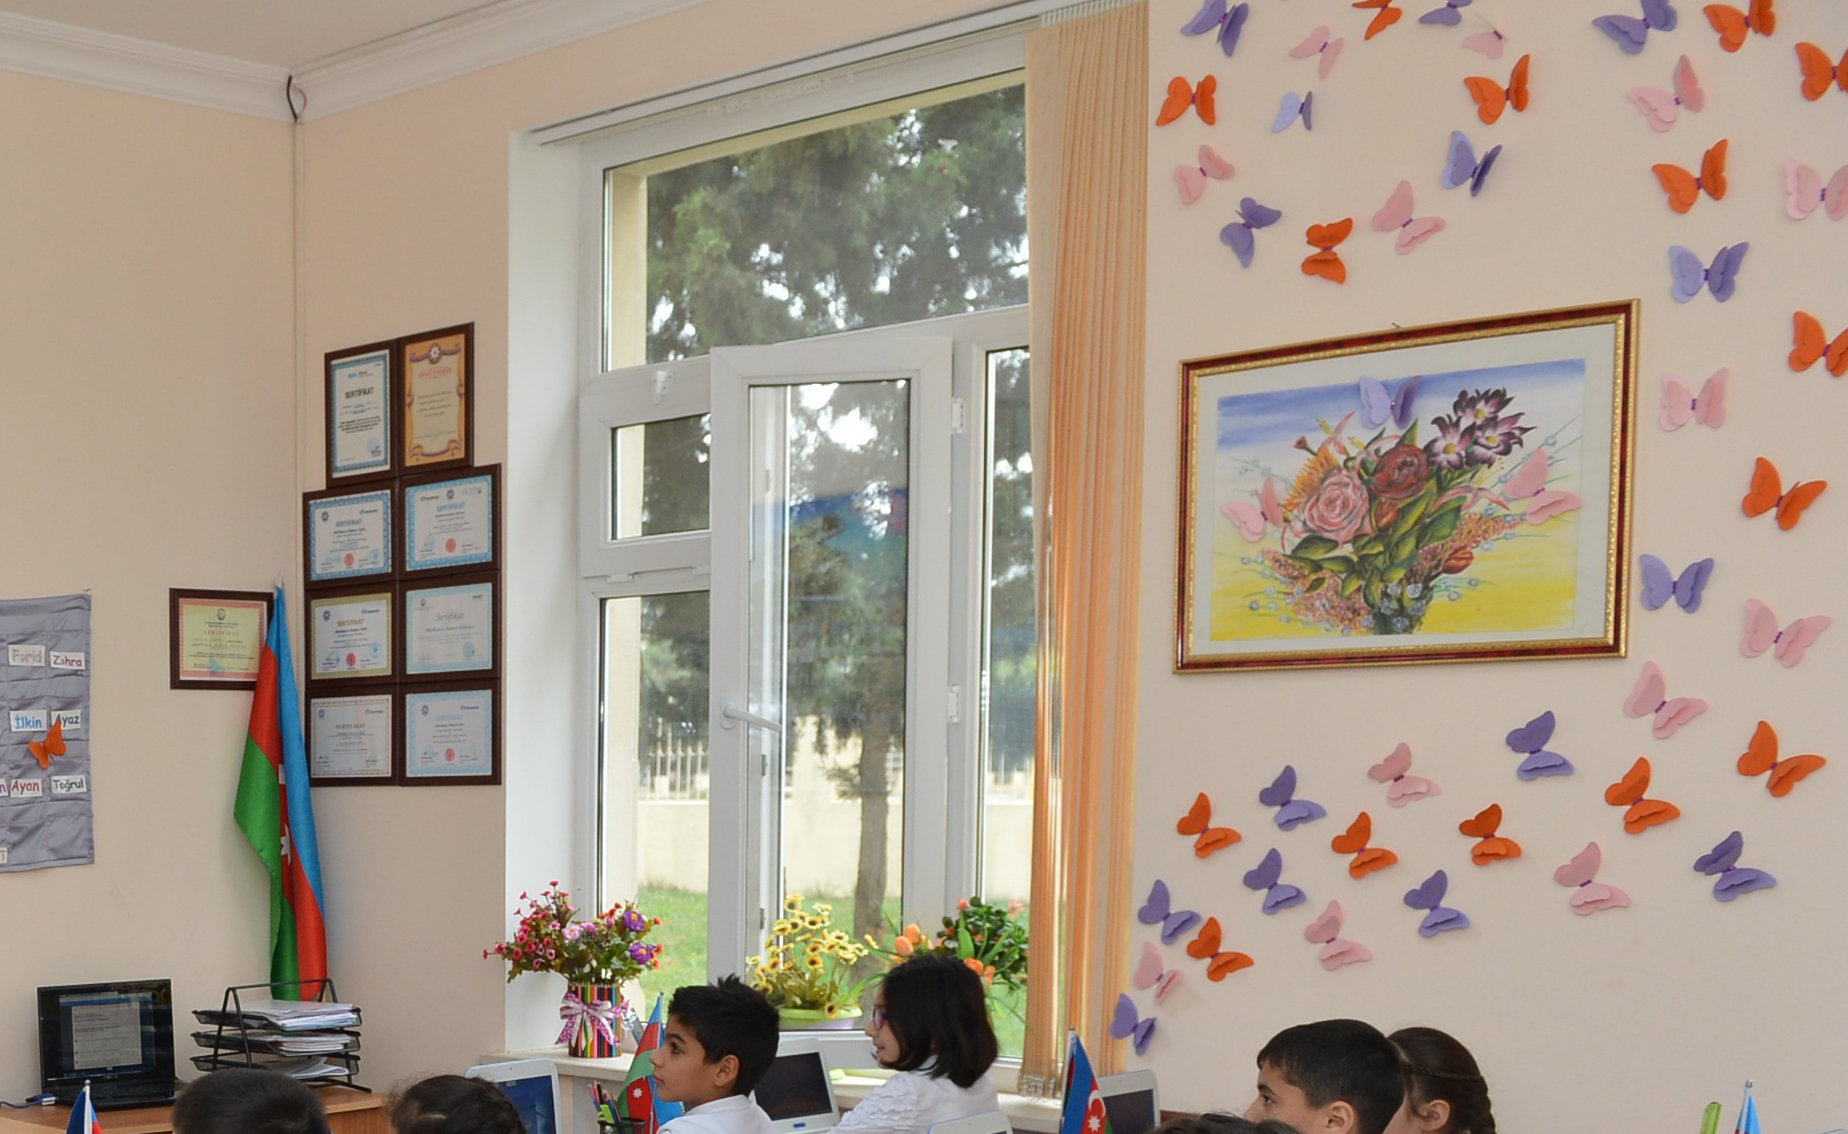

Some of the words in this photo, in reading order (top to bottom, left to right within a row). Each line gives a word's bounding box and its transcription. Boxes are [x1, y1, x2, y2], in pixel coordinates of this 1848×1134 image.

[12, 649, 42, 663] Fərid
[53, 655, 82, 667] Zəhra
[15, 714, 42, 729] İlkin
[55, 713, 80, 728] Ayaz
[12, 780, 40, 795] Ayan
[54, 778, 84, 792] Toğrul
